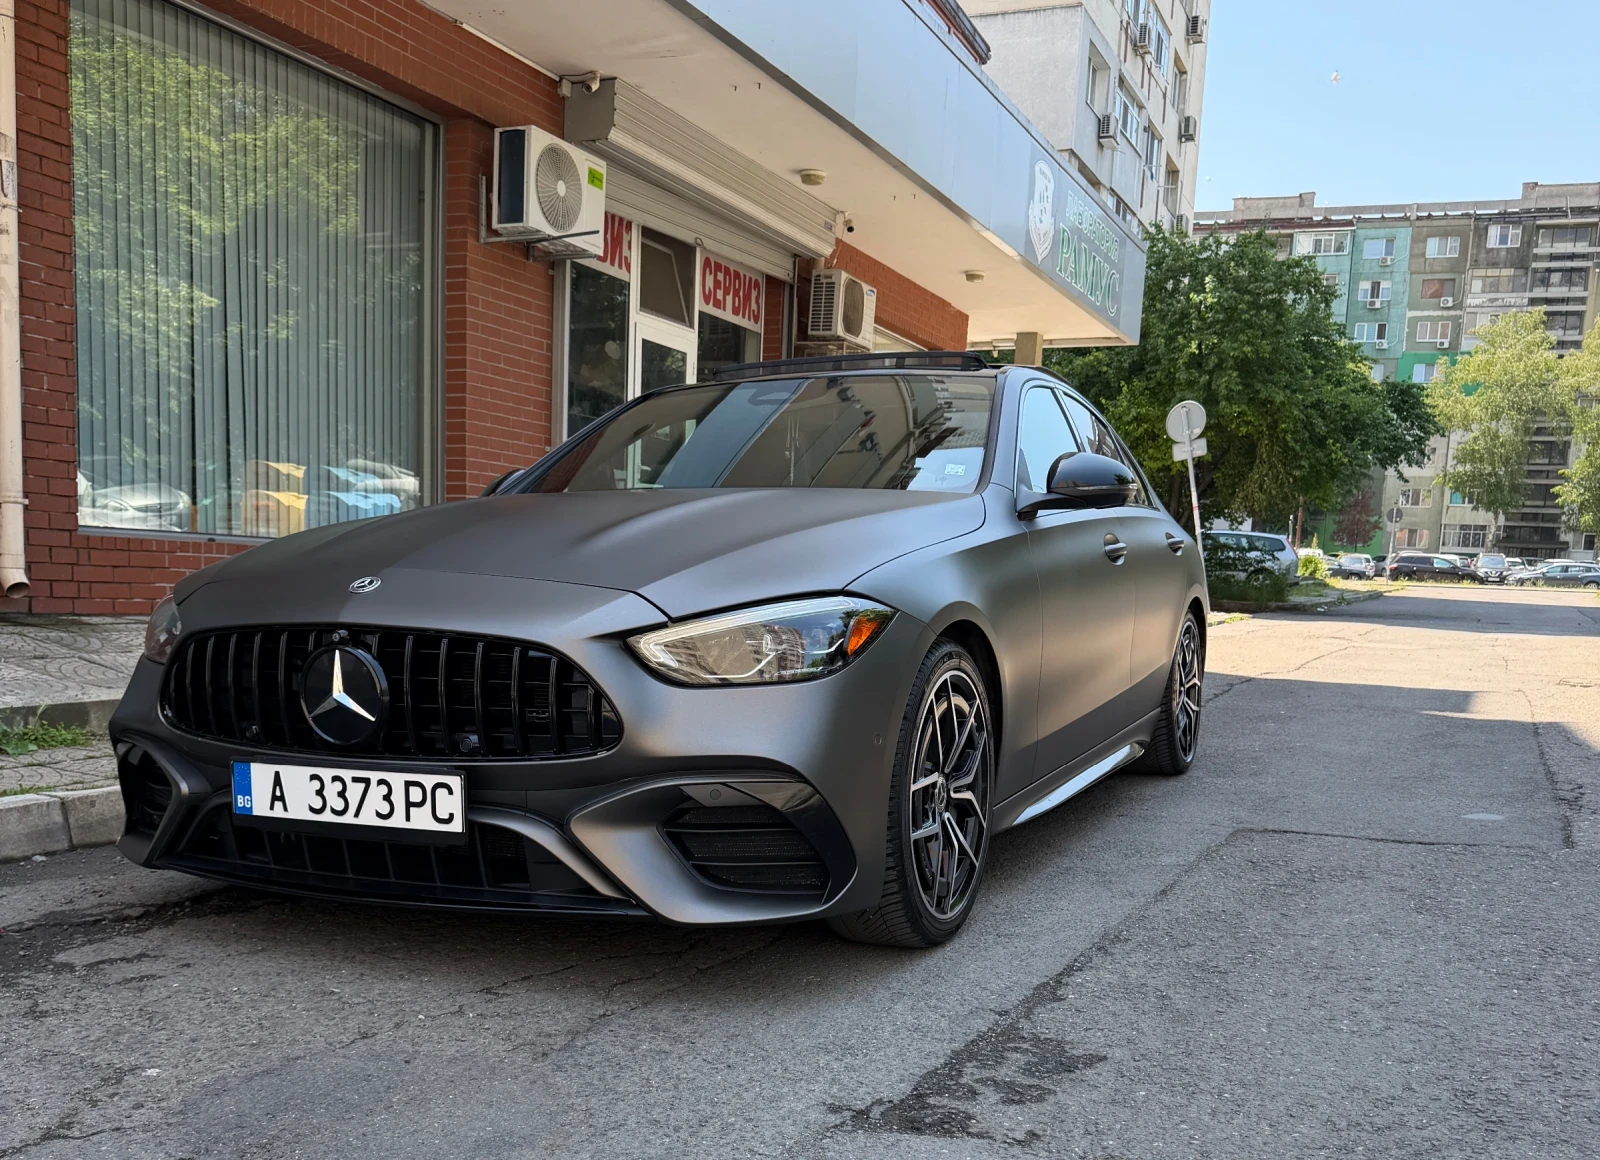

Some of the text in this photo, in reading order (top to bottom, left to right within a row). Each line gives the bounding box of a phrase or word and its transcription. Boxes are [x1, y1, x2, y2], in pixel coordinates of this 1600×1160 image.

[701, 256, 761, 325] СЕРВИЗ
[1056, 222, 1120, 317] РАМУС
[237, 795, 252, 808] BG
[269, 770, 289, 813] A
